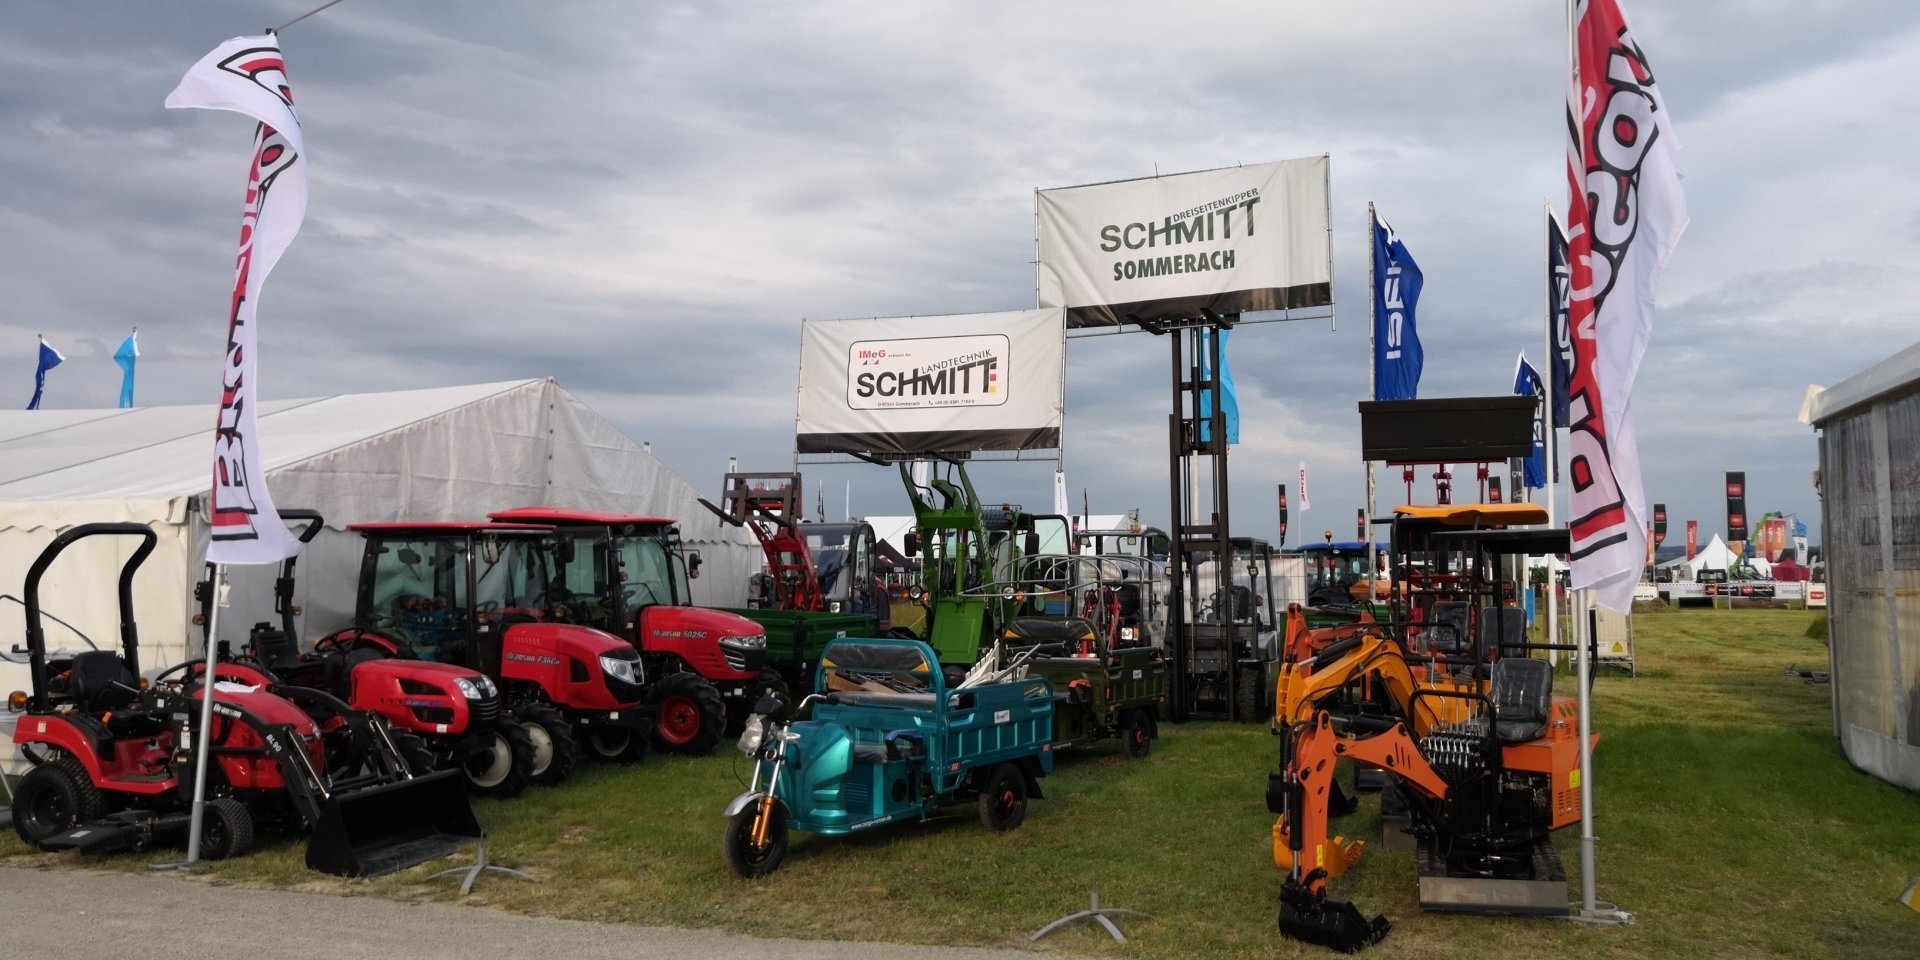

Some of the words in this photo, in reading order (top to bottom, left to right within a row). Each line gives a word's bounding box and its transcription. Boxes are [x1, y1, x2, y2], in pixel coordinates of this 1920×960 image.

[1173, 188, 1259, 222] DREISEITENKIPPER
[1100, 197, 1261, 252] SCHMITT
[1114, 250, 1235, 281] SOMMERACH
[859, 350, 886, 359] IMeG
[921, 349, 992, 374] LANDTECHNIK
[856, 356, 997, 398] SCHMITT
[266, 734, 282, 752] BL90
